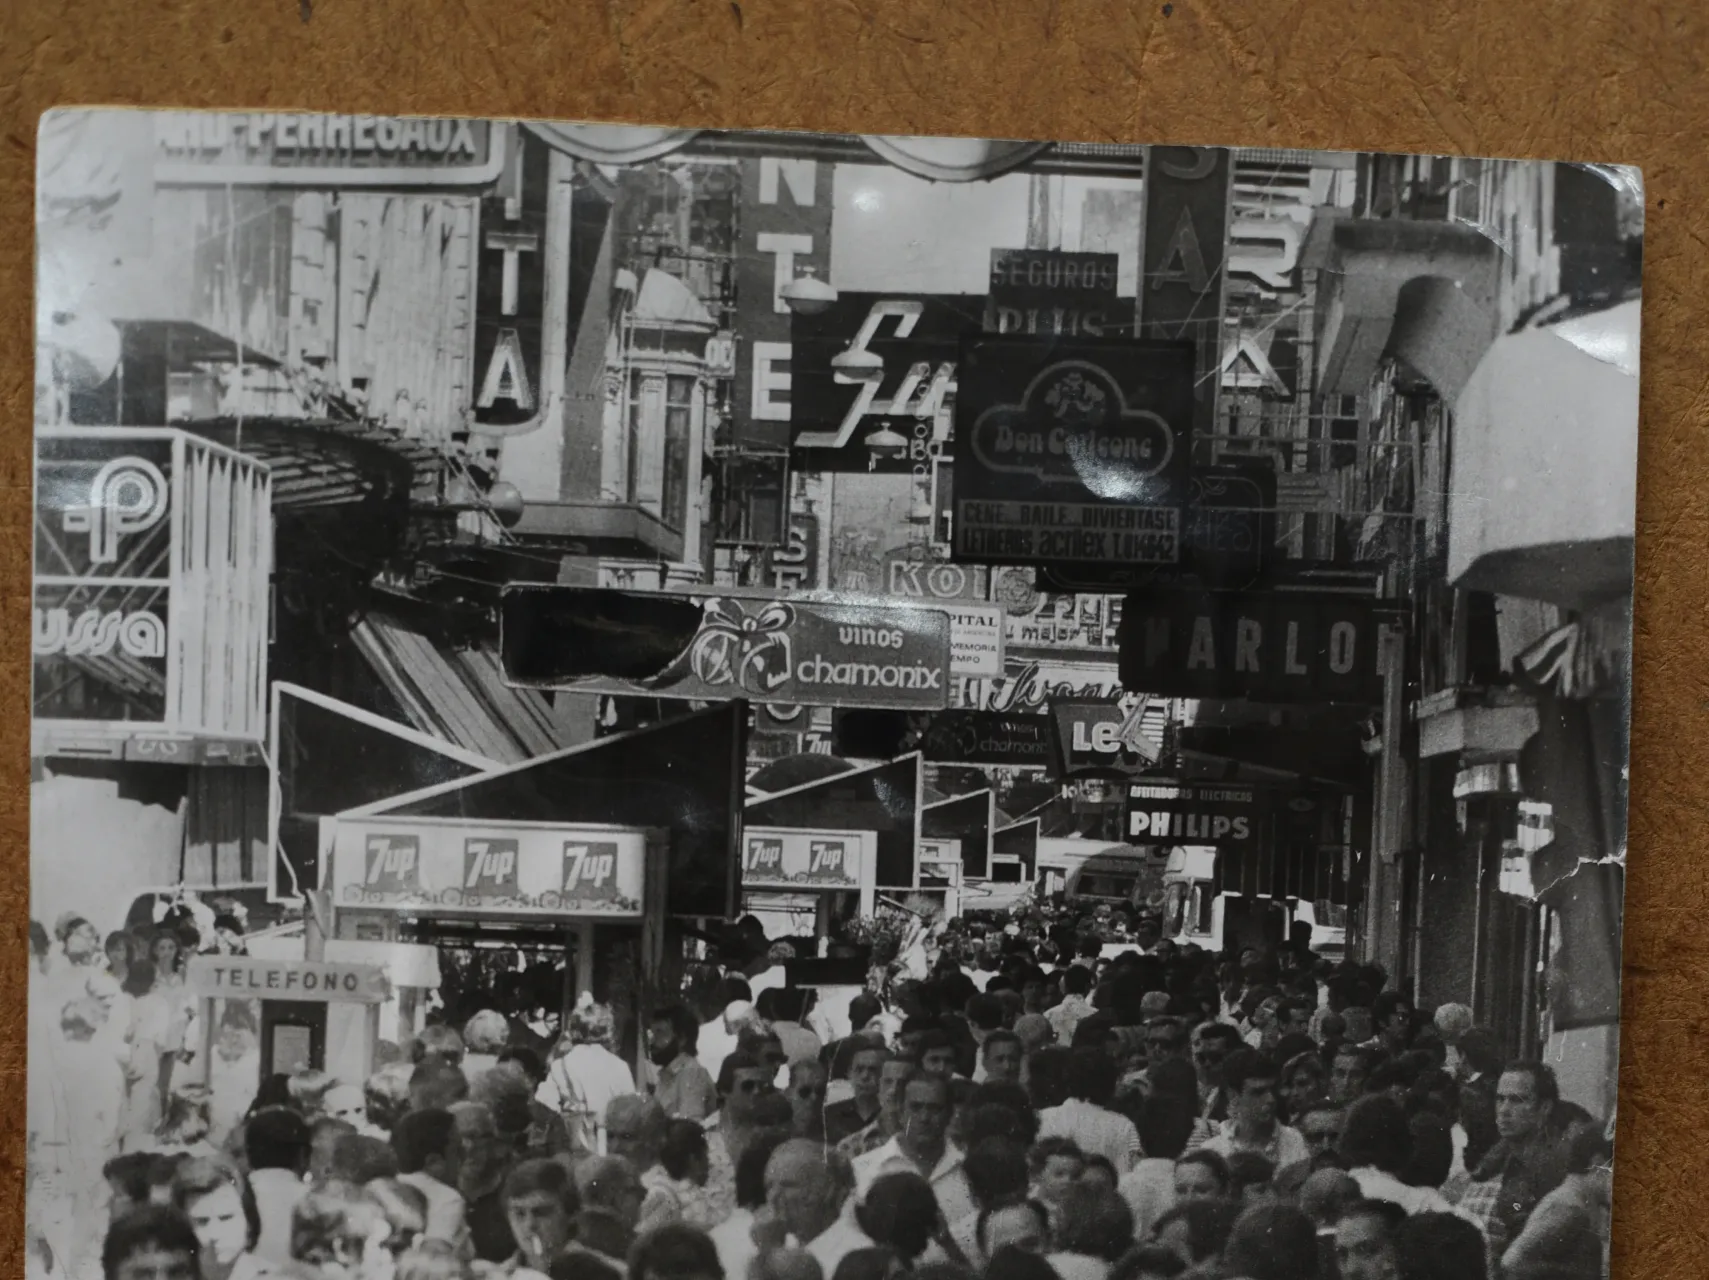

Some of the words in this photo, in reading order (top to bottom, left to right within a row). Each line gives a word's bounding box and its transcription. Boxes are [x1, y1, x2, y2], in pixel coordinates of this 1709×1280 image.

[991, 258, 1117, 291] SEGUROS
[994, 424, 1044, 455] Don
[838, 627, 905, 650] vinos
[796, 652, 941, 690] chamonix
[1129, 810, 1251, 840] PHILIPS
[366, 834, 417, 884] 7up
[467, 840, 516, 887] 7up
[564, 844, 614, 891] 7up
[749, 841, 781, 871] 7up
[810, 843, 843, 873] 7up
[213, 967, 360, 992] TELEFONO
